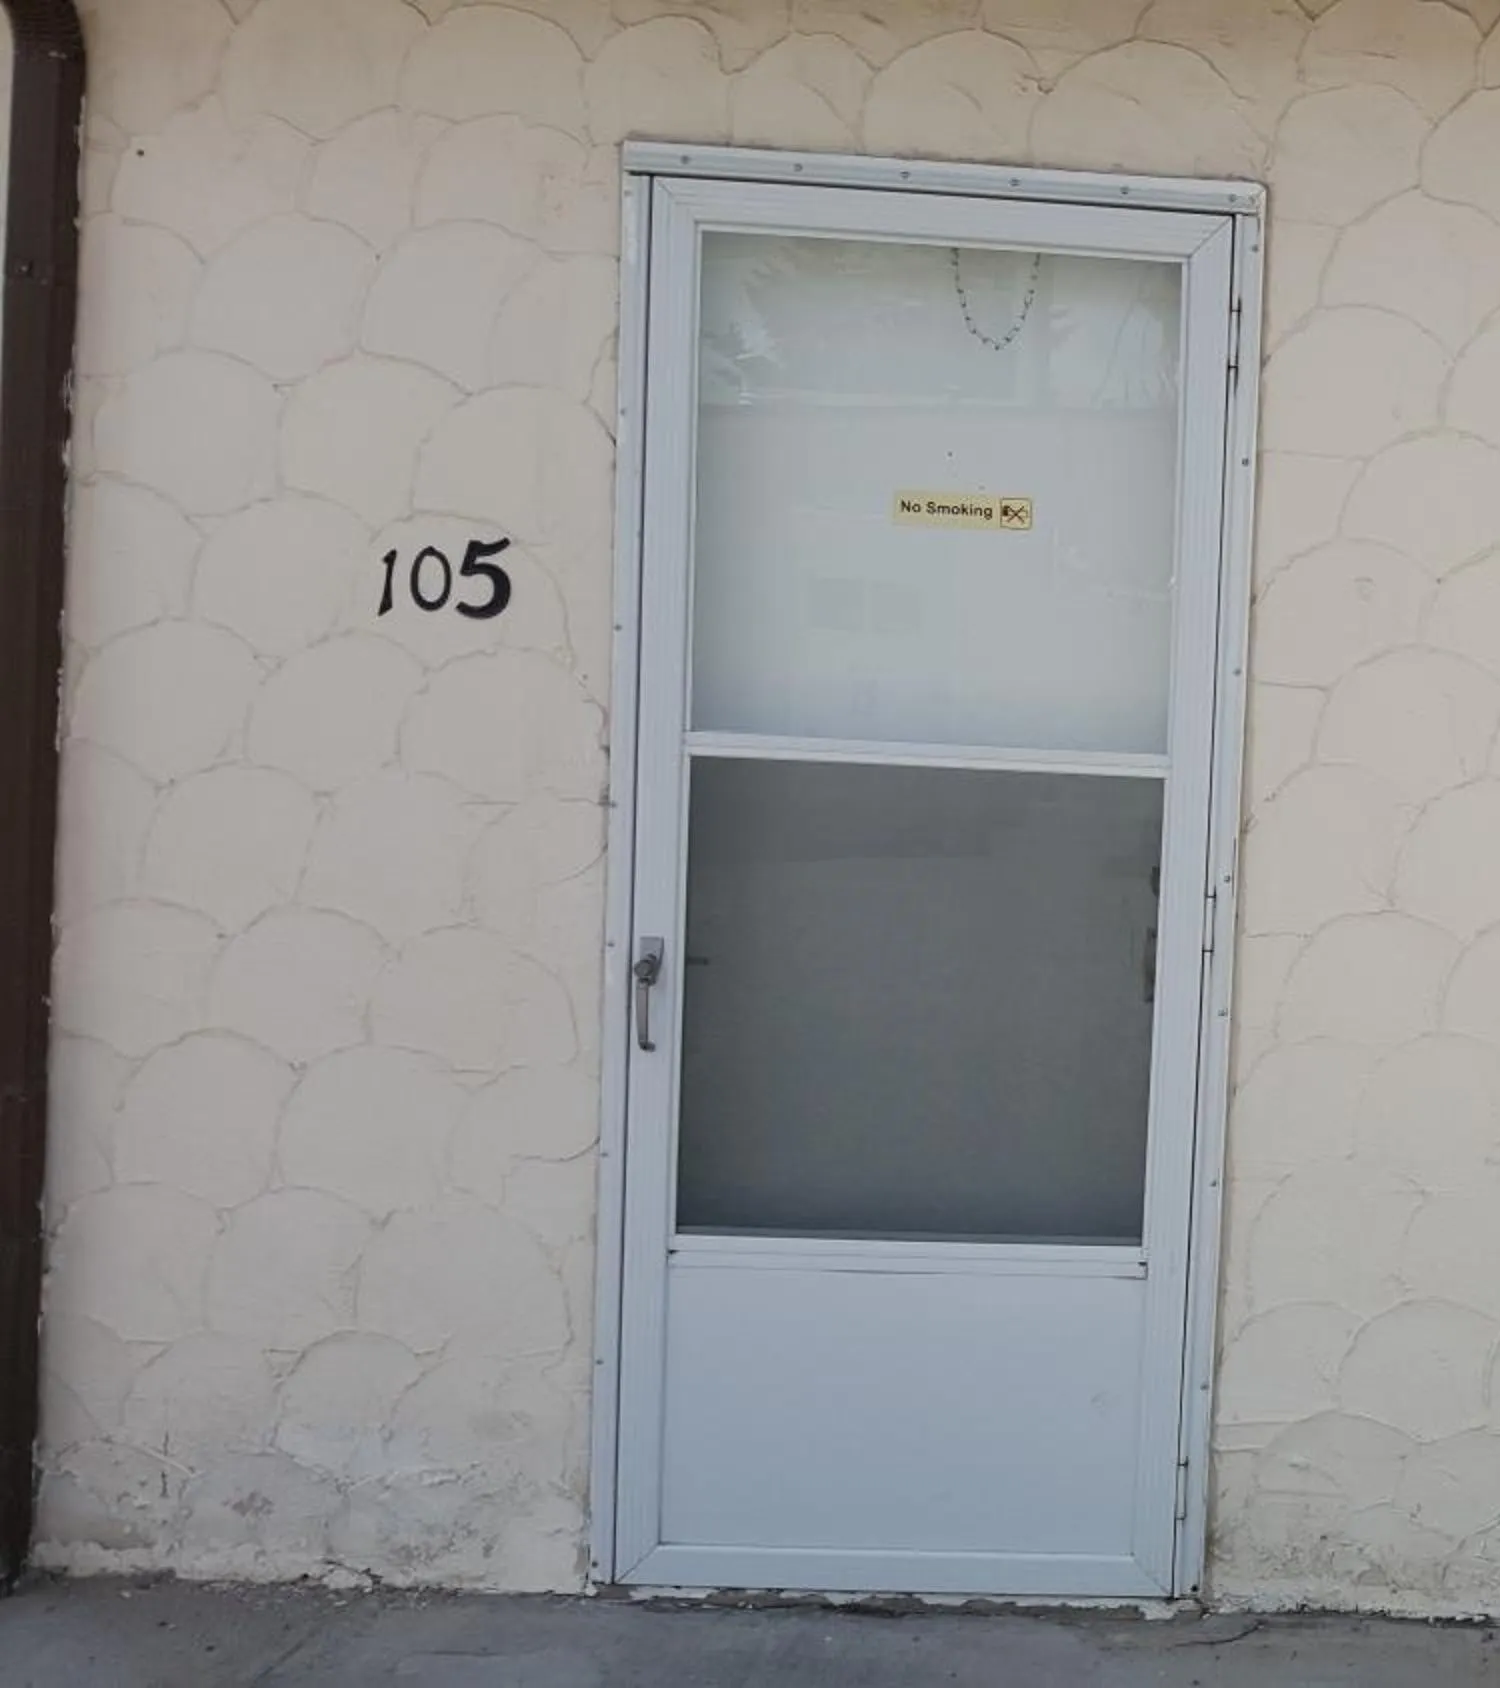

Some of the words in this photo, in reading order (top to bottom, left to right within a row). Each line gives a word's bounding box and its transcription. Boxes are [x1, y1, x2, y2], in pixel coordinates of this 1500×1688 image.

[900, 500, 921, 513] No
[926, 501, 993, 520] Smoking
[377, 537, 512, 620] 105
